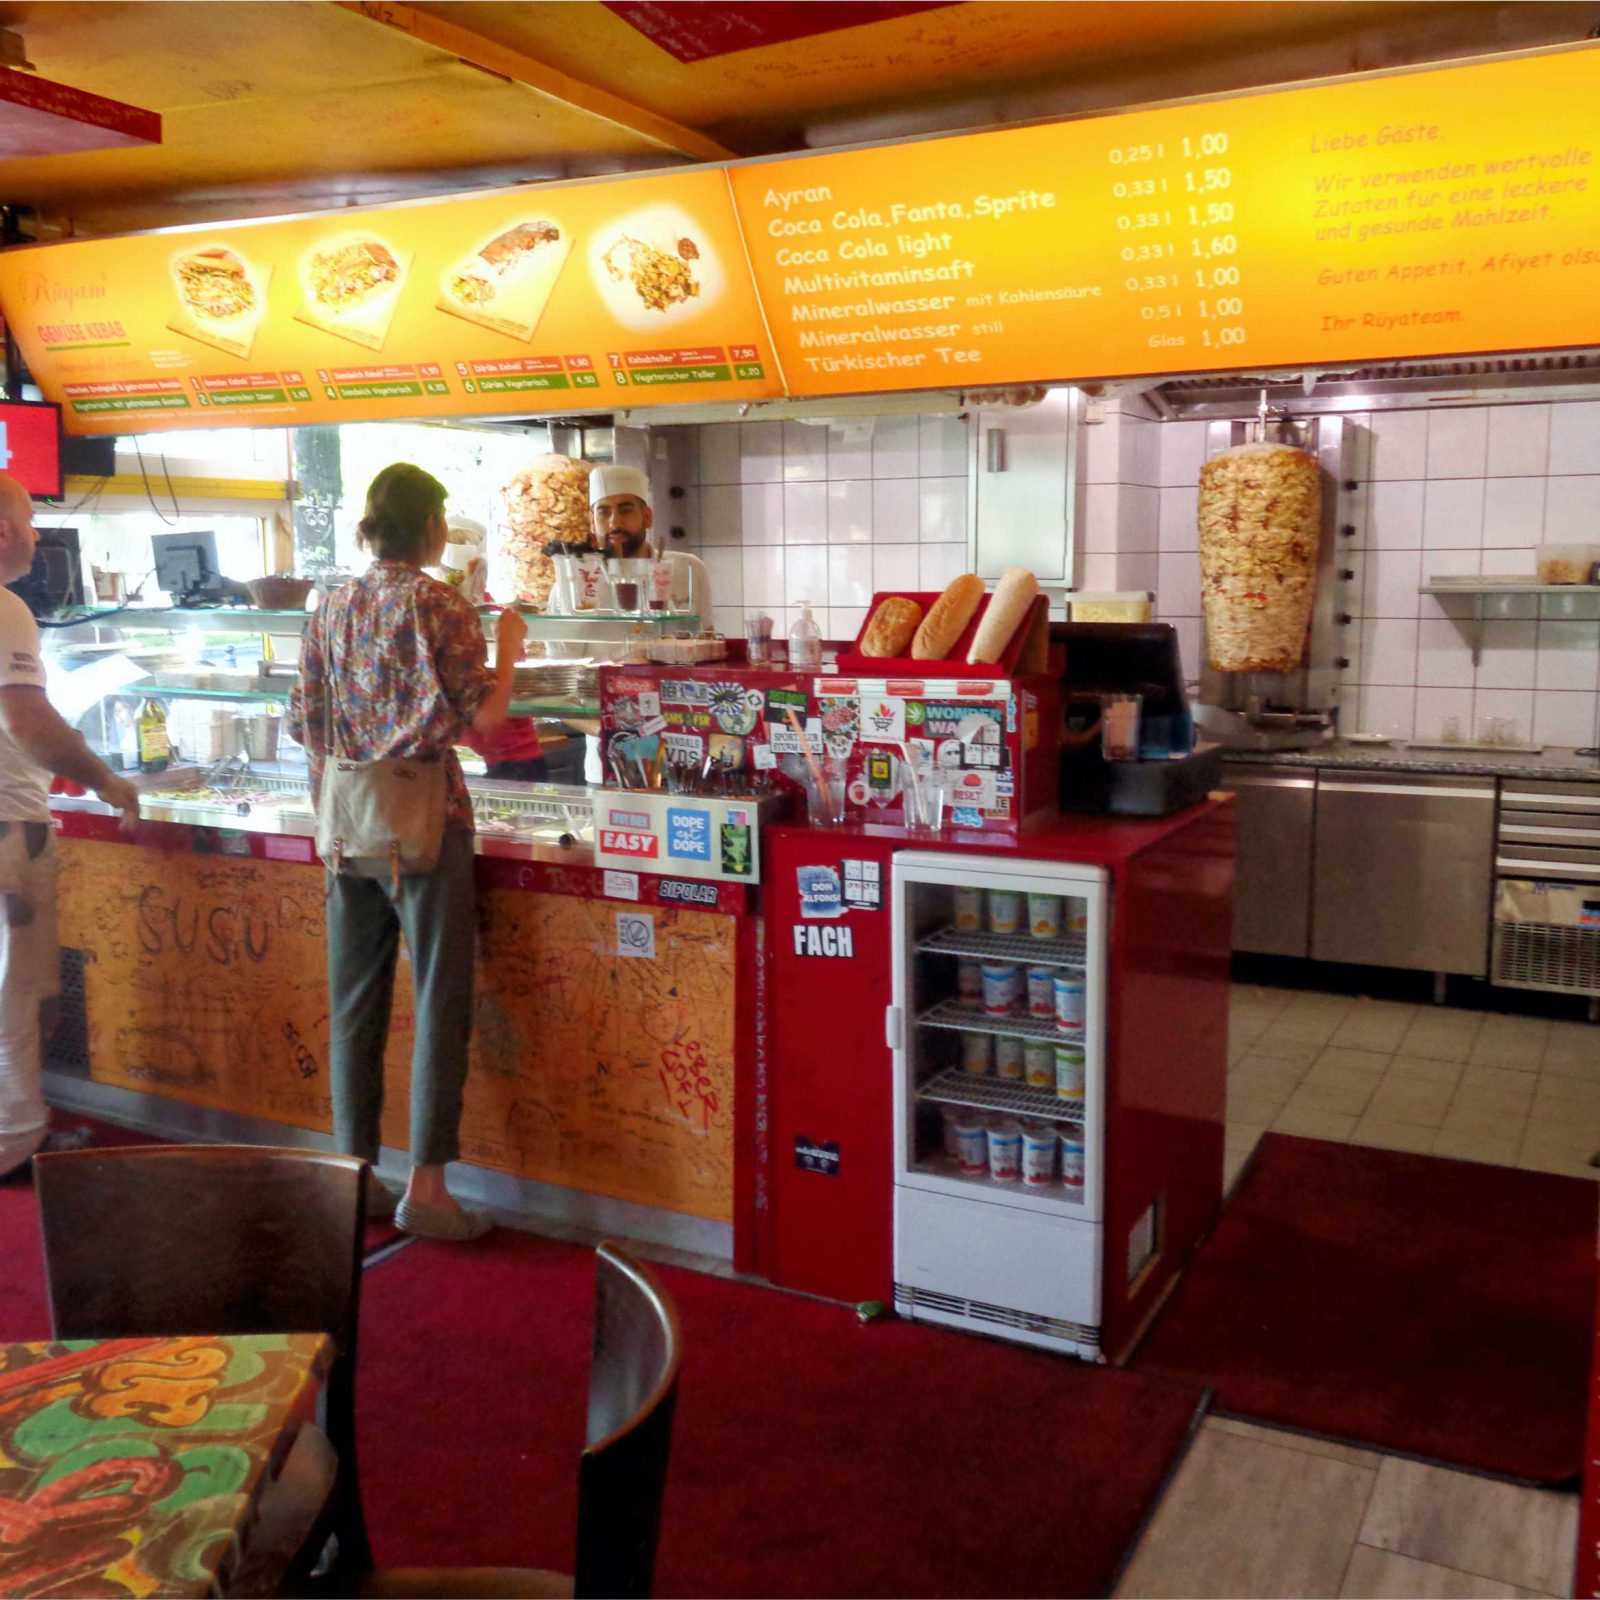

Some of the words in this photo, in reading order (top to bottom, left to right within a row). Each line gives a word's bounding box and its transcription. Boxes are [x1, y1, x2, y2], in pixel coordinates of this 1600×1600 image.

[763, 185, 832, 208] Ayran
[1109, 147, 1153, 166] 0,25
[1182, 132, 1228, 160] 1,00
[1360, 160, 1477, 189] verwenden
[1484, 145, 1592, 175] wertvolle
[1503, 175, 1588, 200] leckere
[768, 214, 827, 239] Coca
[1113, 179, 1155, 199] 0,33
[1185, 167, 1232, 195] 1,50
[776, 243, 830, 268] Coca
[839, 240, 888, 262] Cola
[898, 230, 954, 259] light
[1117, 212, 1160, 232] 0,33
[1188, 202, 1234, 229] 1,50
[1316, 220, 1351, 242] und
[1357, 211, 1443, 242] gesunde
[783, 260, 976, 296] Multivitaminsaft
[1121, 244, 1164, 263] 0,33
[1191, 234, 1237, 261] 1,60
[1318, 267, 1378, 286] Guten
[1481, 250, 1553, 276] Afiyet
[791, 293, 956, 323] Mineralwasser
[966, 291, 995, 308] mit
[1125, 274, 1168, 292] 0,33
[1195, 265, 1240, 290] 1,00
[799, 321, 962, 349] Mineralwasser
[971, 320, 1004, 336] still
[1141, 304, 1171, 322] 0,5
[1199, 297, 1243, 320] 1,00
[609, 354, 619, 368] 7
[733, 349, 755, 359] 7,50
[805, 350, 927, 374] Türkischer
[935, 345, 983, 366] Tee
[1148, 332, 1186, 348] Glas
[1202, 327, 1246, 350] 1,00
[319, 370, 329, 384] 3
[457, 361, 468, 376] 5
[615, 371, 627, 385] 8
[326, 387, 337, 399] 4
[464, 380, 475, 393] 6
[198, 392, 209, 406] 2
[672, 815, 705, 829] DOPE
[604, 832, 654, 852] EASY
[673, 839, 706, 854] DOPE
[659, 880, 719, 904] BIPOLAR
[811, 883, 833, 892] DON
[793, 925, 854, 958] FACH
